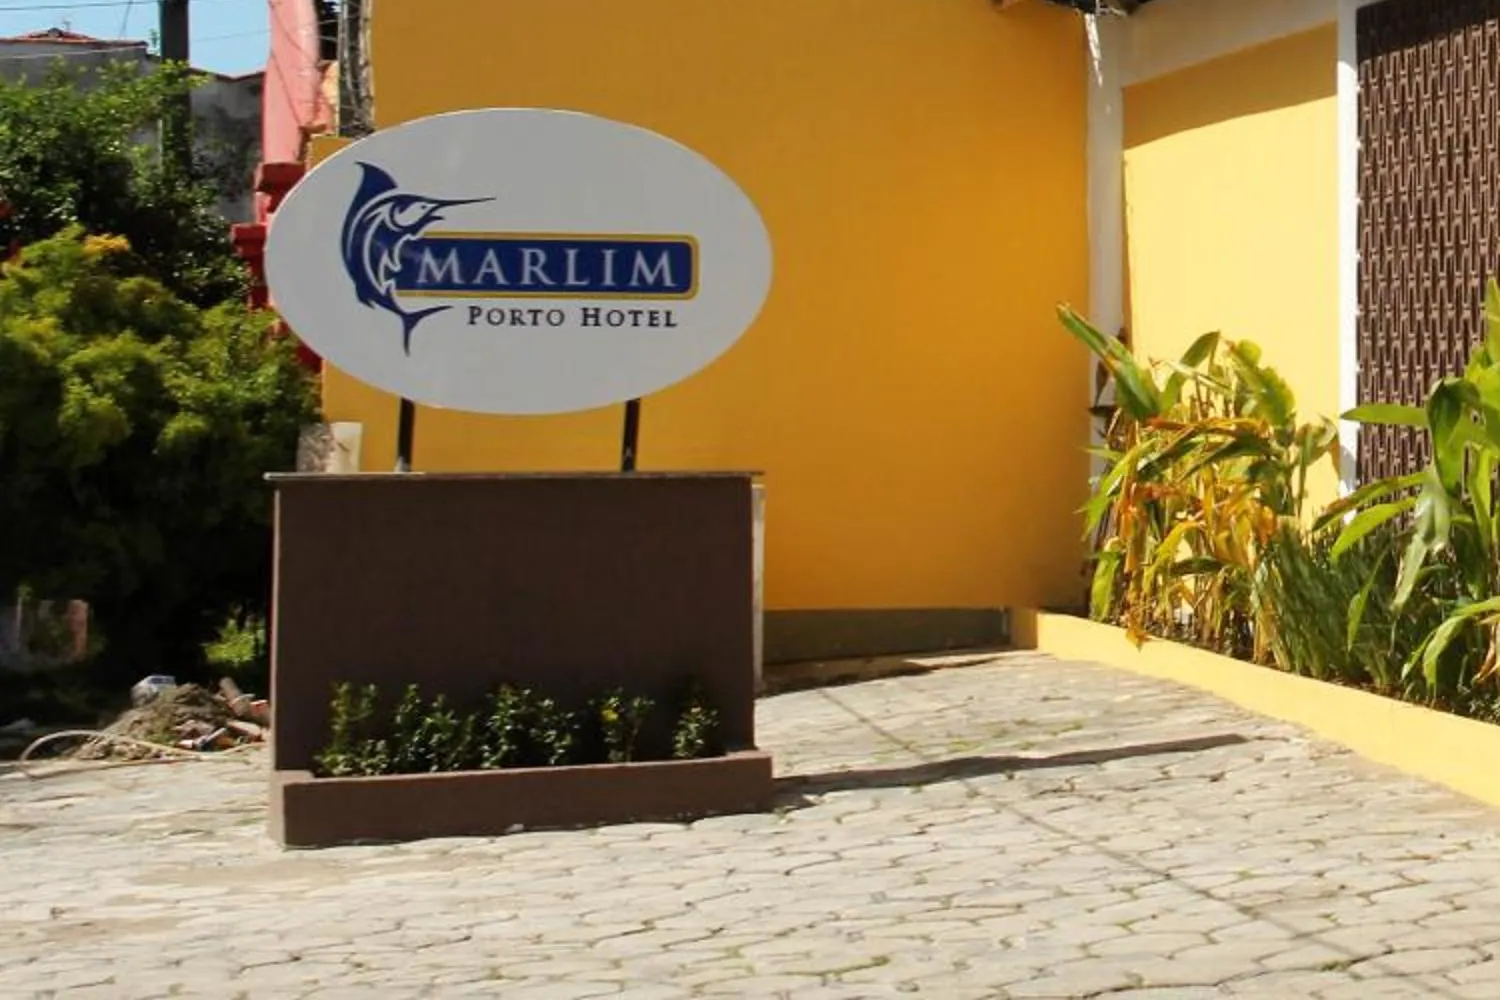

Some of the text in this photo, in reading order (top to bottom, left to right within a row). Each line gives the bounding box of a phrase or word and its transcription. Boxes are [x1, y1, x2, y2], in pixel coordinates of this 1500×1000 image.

[416, 247, 677, 287] MARLIM
[468, 305, 679, 328] PORTO HOTEL
